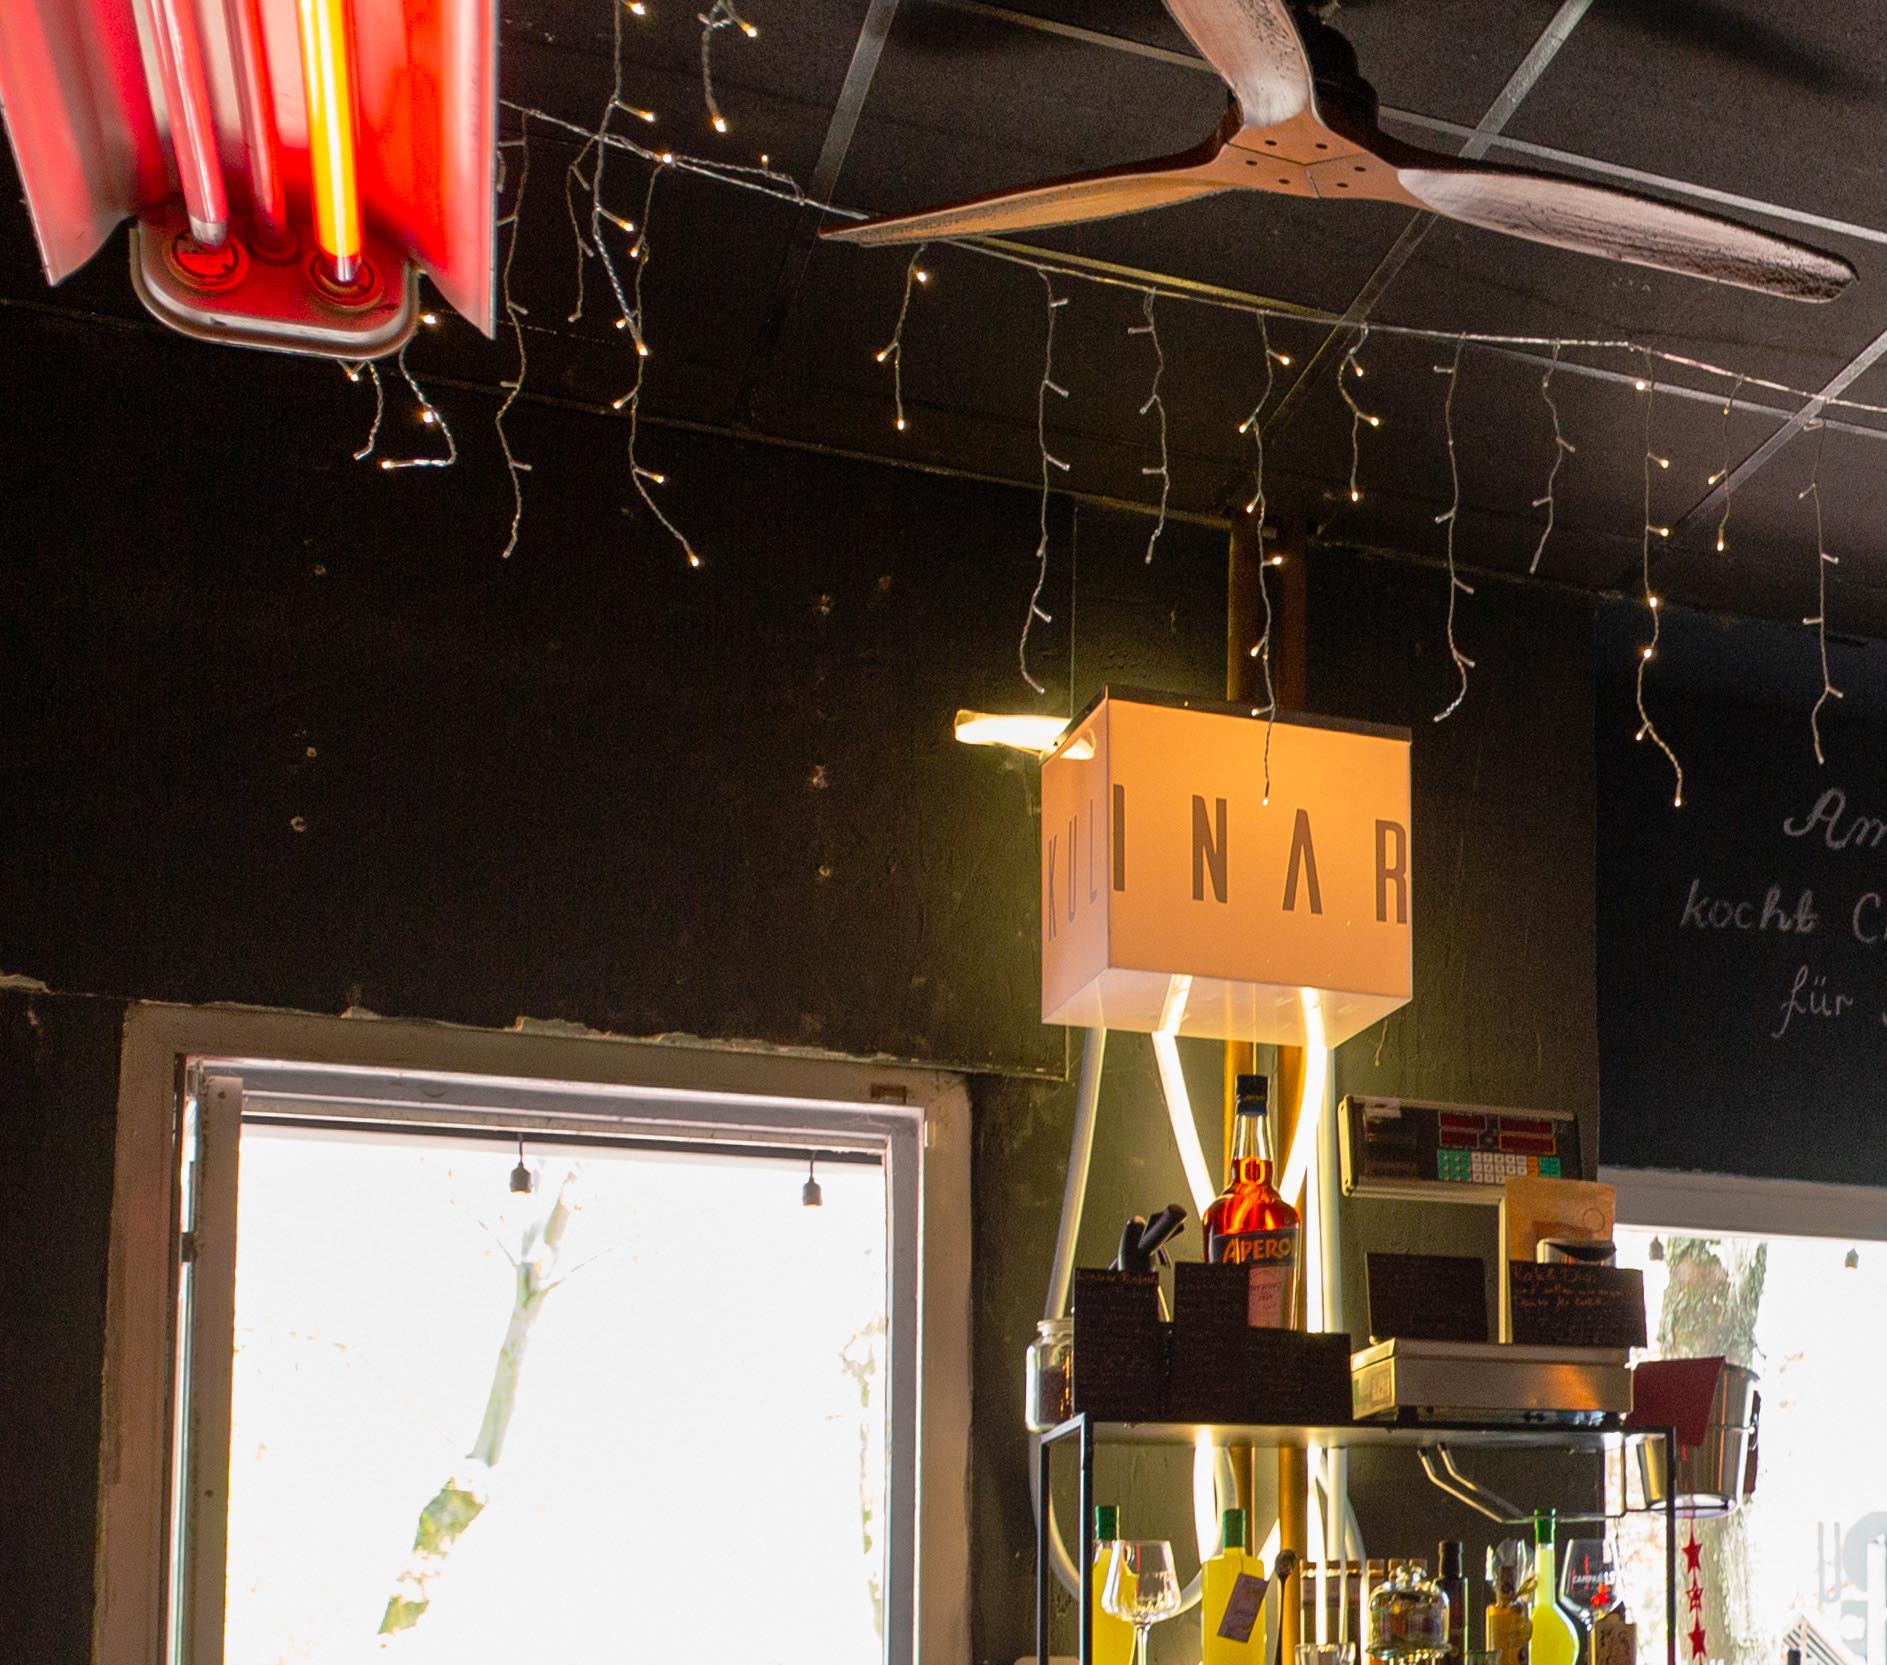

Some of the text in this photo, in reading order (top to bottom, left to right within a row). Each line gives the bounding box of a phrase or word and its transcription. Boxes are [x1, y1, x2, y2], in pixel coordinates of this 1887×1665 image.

[1680, 879, 1816, 935] kocht
[1772, 965, 1854, 1039] für
[1223, 1238, 1294, 1265] APERO
